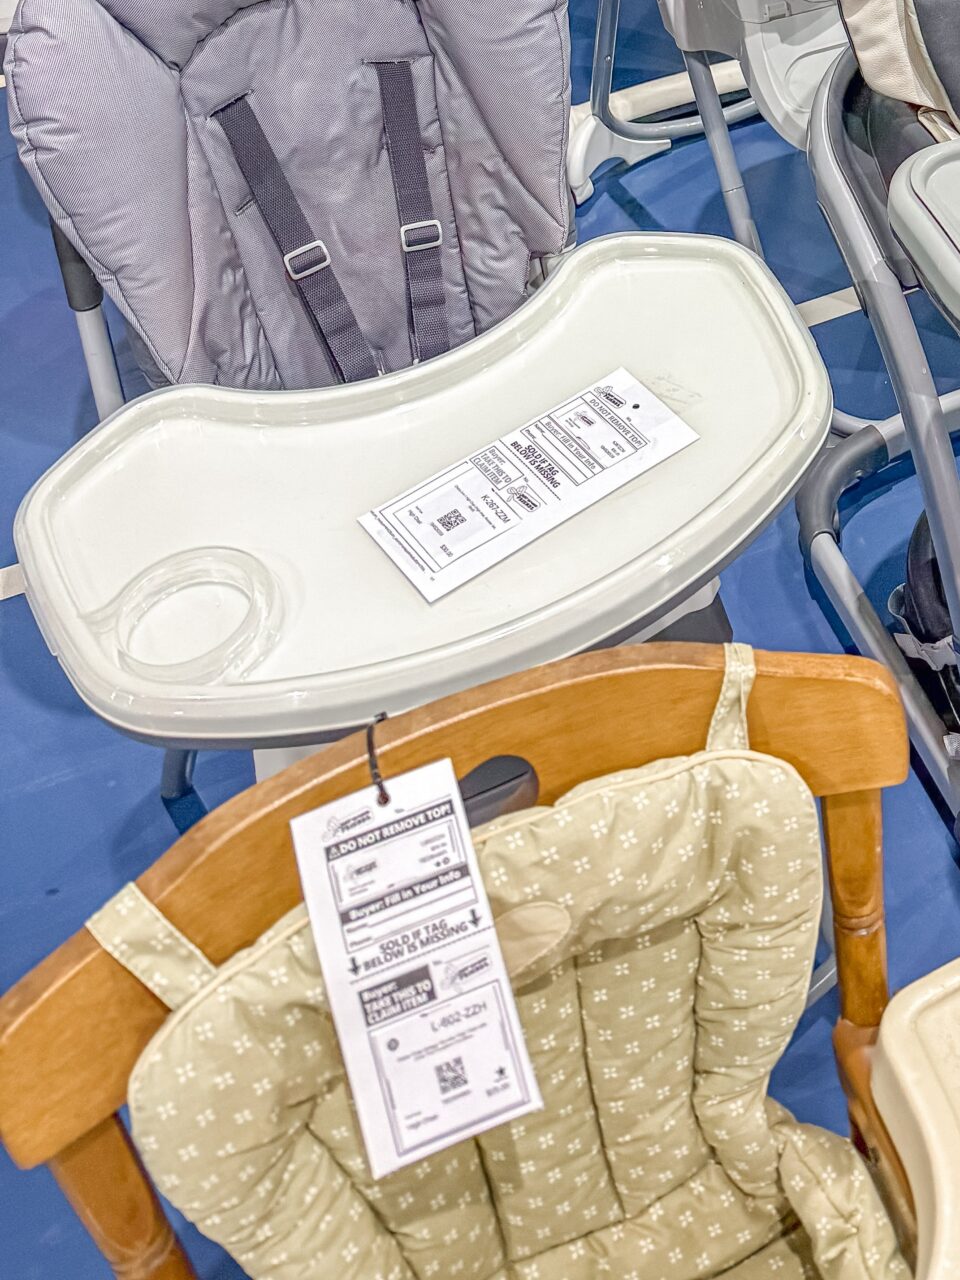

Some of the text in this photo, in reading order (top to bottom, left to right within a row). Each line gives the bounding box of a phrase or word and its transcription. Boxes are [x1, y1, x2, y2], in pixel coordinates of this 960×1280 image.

[589, 398, 643, 446] DO NOT REMOVE TOP!
[487, 448, 506, 465] Buyer:
[524, 444, 559, 475] SOLD IF TAG
[543, 421, 562, 437] Buyer:
[559, 435, 570, 444] Fill
[572, 447, 586, 460] Your
[583, 458, 597, 469] Info
[472, 457, 491, 473] CLAIM
[486, 471, 502, 485] ITEM
[479, 453, 512, 483] TAKE THIS TO
[509, 440, 532, 461] BELOW
[533, 463, 561, 488] MISSING
[480, 494, 511, 523] K-267-ZZM
[339, 803, 451, 854] DO NOT REMOVE TOP!
[413, 877, 439, 894] Your
[439, 868, 461, 884] Info
[363, 920, 468, 971] BELOW IS MISSING
[379, 918, 448, 954] SOLD IF TAG
[416, 978, 432, 994] TO
